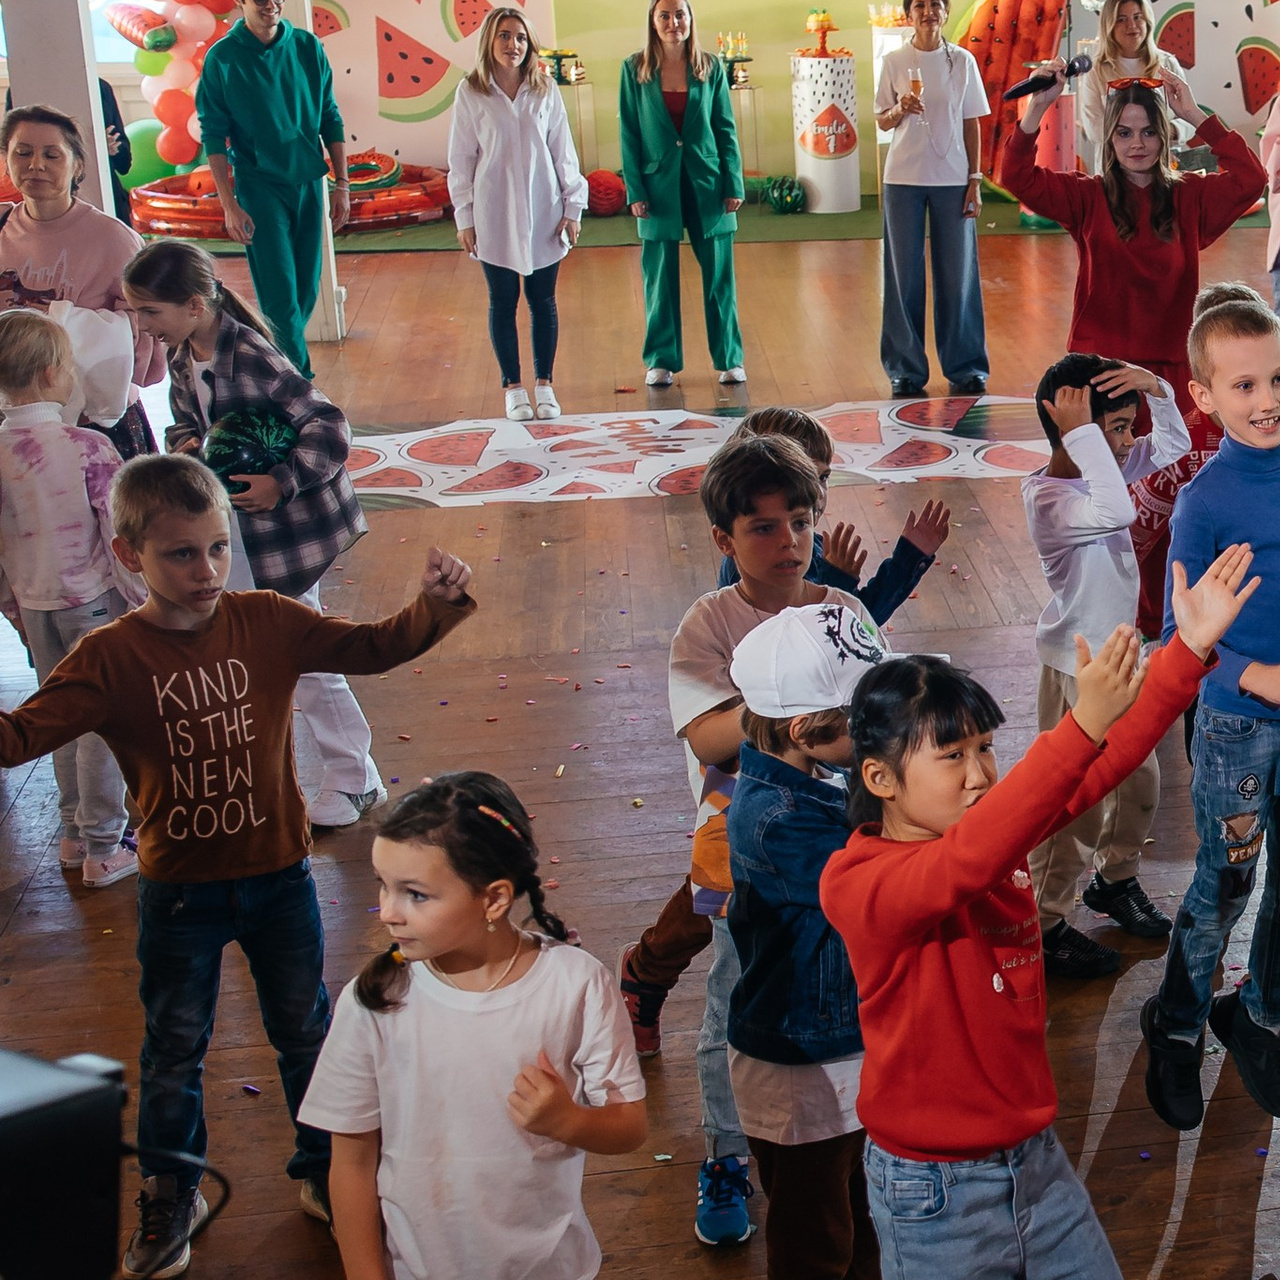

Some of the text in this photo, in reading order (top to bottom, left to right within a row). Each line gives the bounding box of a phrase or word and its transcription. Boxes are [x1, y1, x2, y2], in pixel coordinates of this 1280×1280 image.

[812, 119, 847, 136] Emilie
[153, 658, 249, 717] KIND
[165, 704, 256, 757] IS THE
[171, 749, 252, 800] NEW
[167, 792, 267, 841] COOL
